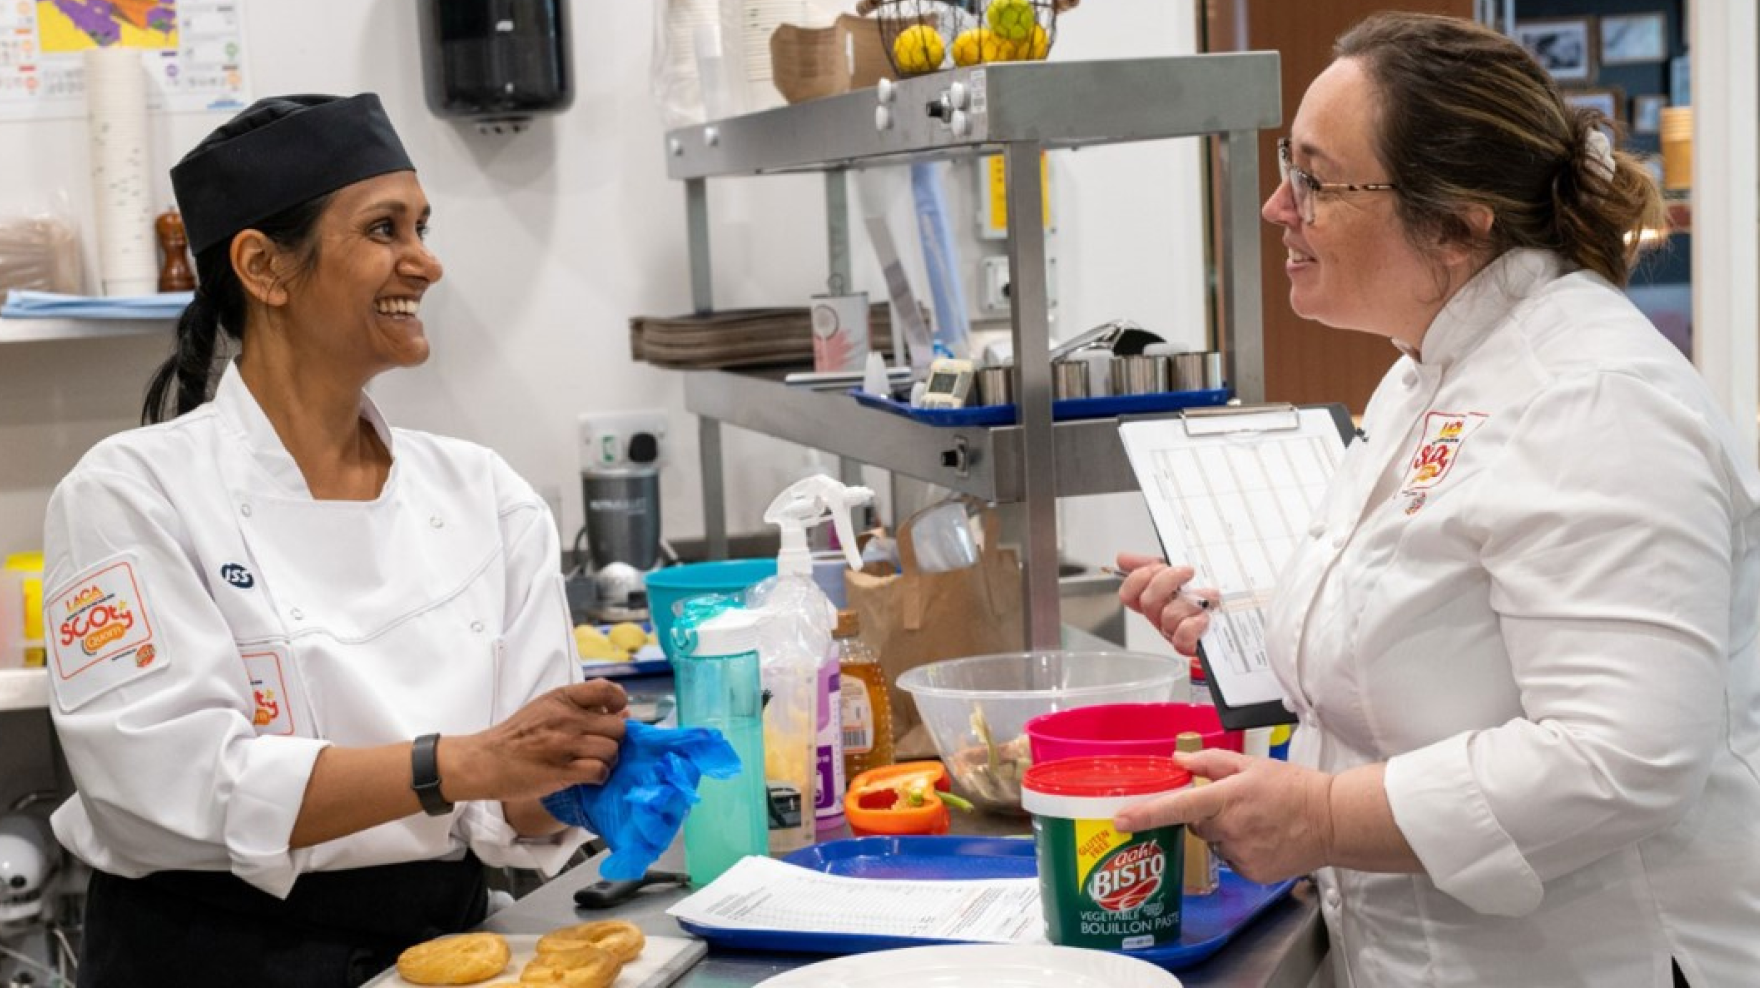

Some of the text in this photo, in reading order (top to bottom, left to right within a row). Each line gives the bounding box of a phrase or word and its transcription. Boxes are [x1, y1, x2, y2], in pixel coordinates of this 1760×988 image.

[225, 567, 250, 584] ISS
[1093, 854, 1165, 899] BISTO
[1080, 910, 1140, 921] VEGETABLE
[1080, 912, 1180, 935] BOUILLON PASTE
